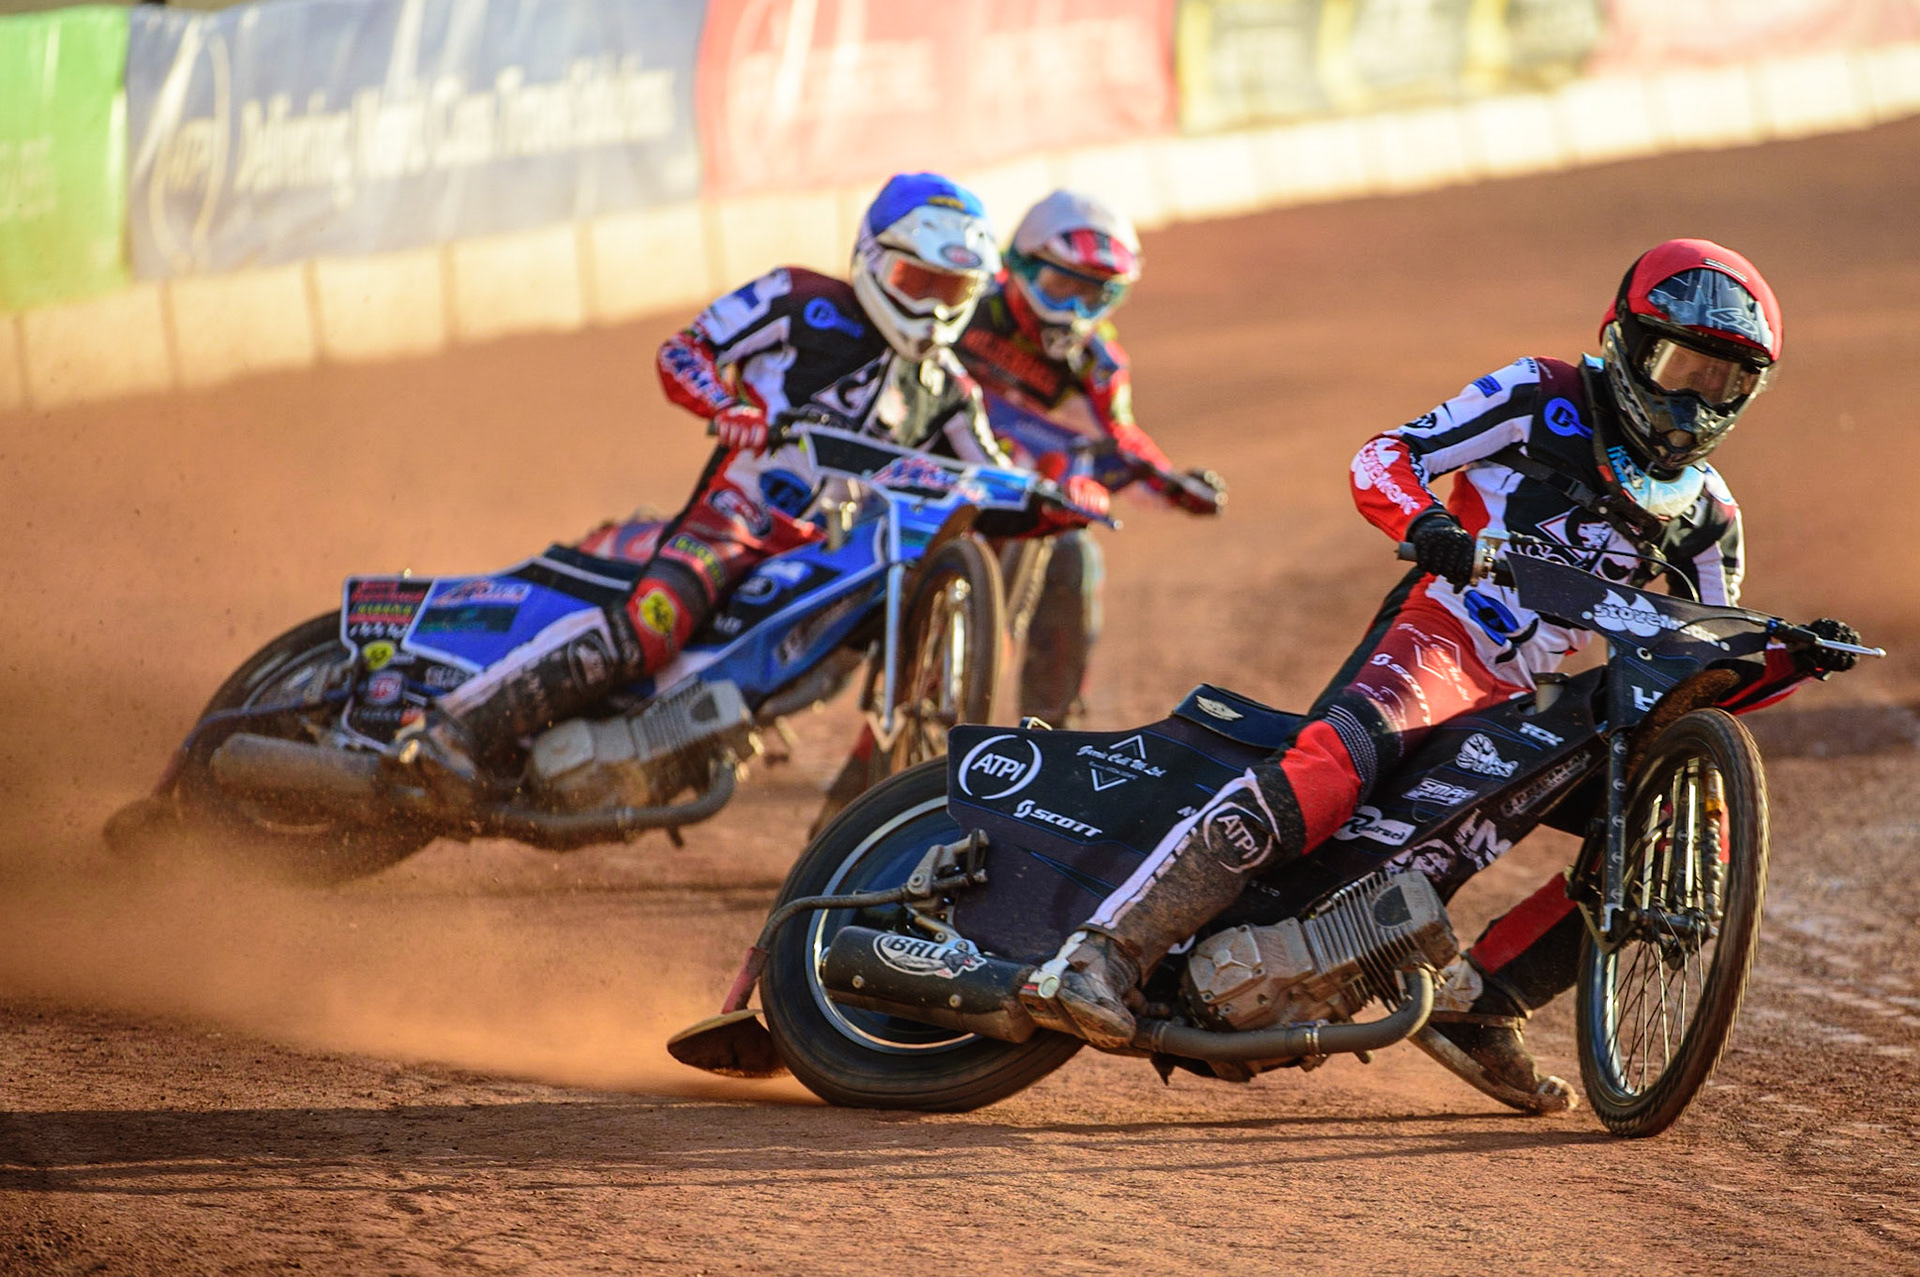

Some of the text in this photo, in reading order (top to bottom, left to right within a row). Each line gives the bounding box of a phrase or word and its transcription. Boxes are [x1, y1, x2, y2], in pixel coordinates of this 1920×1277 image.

[970, 752, 1027, 782] ATPI
[1029, 808, 1103, 838] SCOTT
[1216, 814, 1259, 859] ATPI
